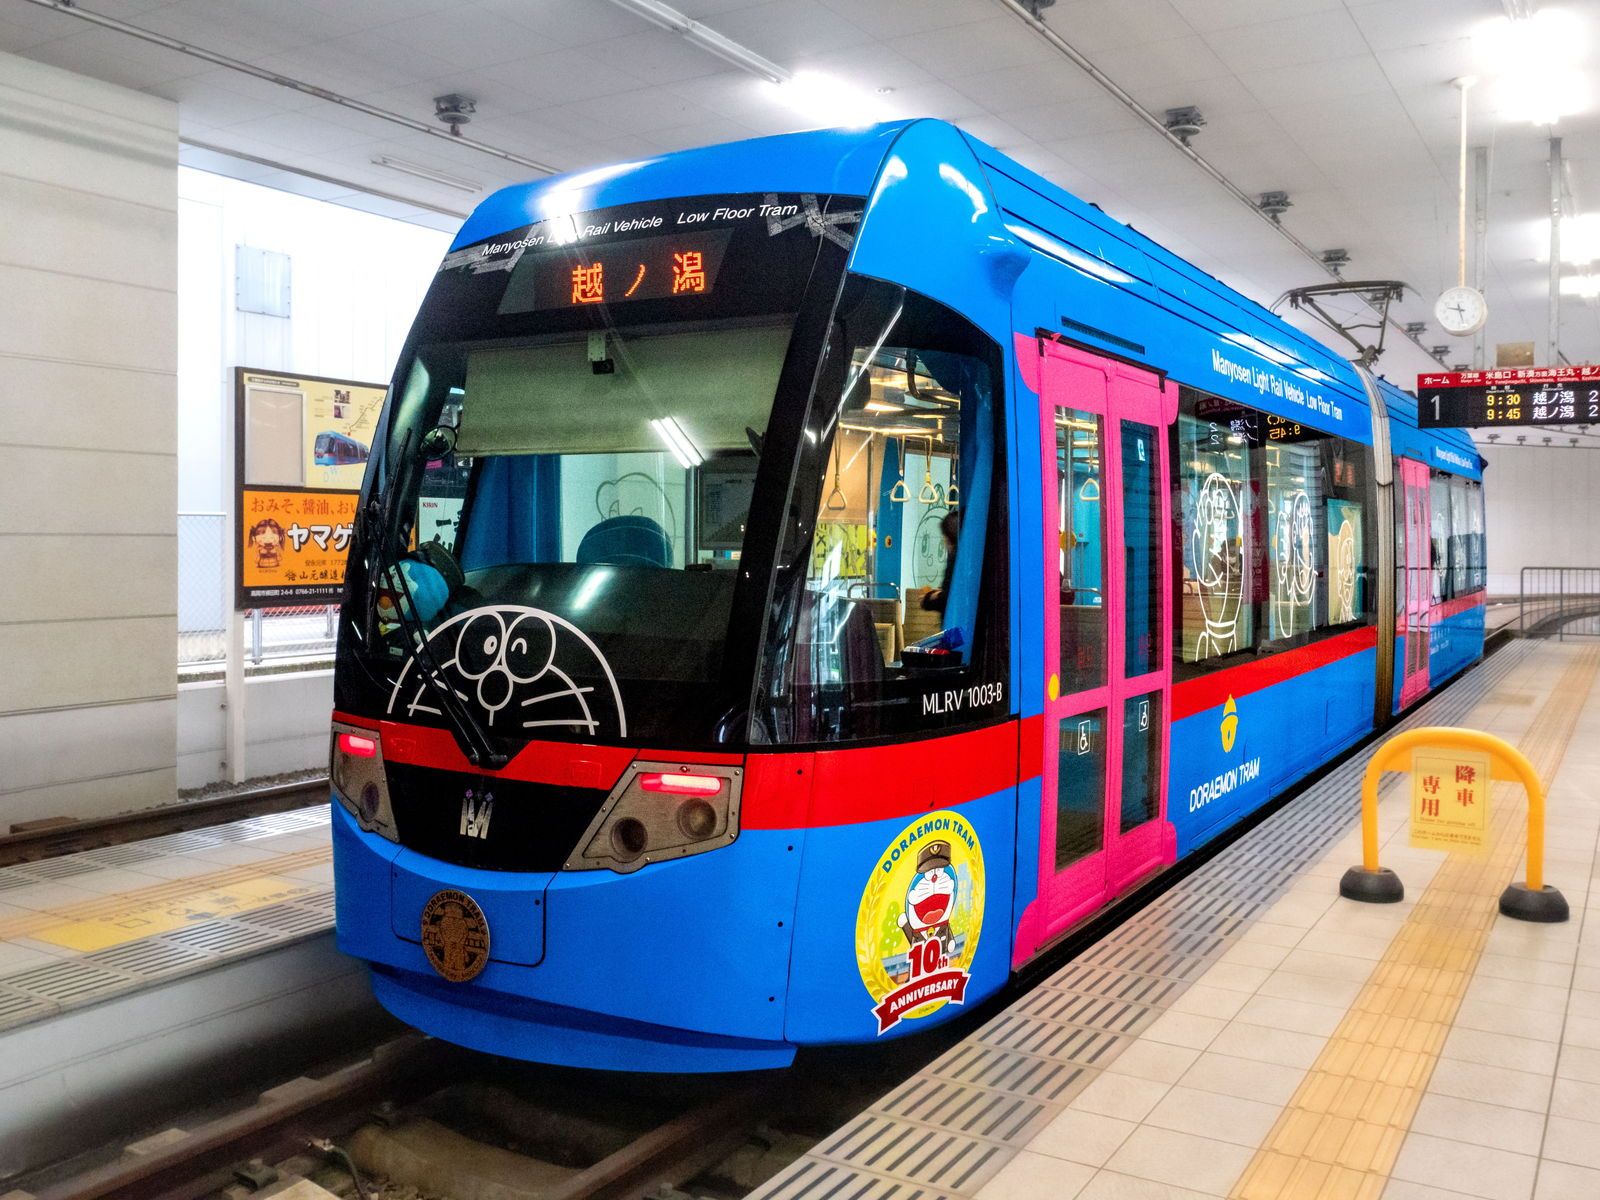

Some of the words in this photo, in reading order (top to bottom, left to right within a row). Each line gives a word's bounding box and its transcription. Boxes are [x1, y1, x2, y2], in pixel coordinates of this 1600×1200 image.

[481, 235, 544, 257] Manyosen
[583, 222, 611, 238] Rail
[613, 216, 664, 233] Vehicle
[676, 210, 709, 225] Low
[712, 205, 754, 221] Floor
[758, 203, 798, 218] Tram
[1211, 348, 1252, 384] Manyosen
[1252, 366, 1270, 395] Light
[1270, 374, 1284, 398] Rail
[1283, 380, 1305, 406] Vehicle
[1305, 390, 1319, 411] Low
[1424, 376, 1450, 385] ホーム
[1430, 395, 1440, 421] 1
[1532, 391, 1575, 405] 越ノ潟
[1532, 405, 1575, 419] 越ノ潟
[299, 569, 345, 581] 山元醸造
[922, 688, 964, 716] MLRV
[967, 682, 1003, 708] 1003-B
[1189, 767, 1238, 813] DORAEMON
[1239, 756, 1260, 786] TRAM
[1455, 765, 1476, 807] 降車
[881, 818, 950, 874] DORAEMON
[952, 820, 975, 851] TRAM
[424, 891, 465, 919] DORAEMON
[888, 977, 959, 1014] ANNIVERSARY
